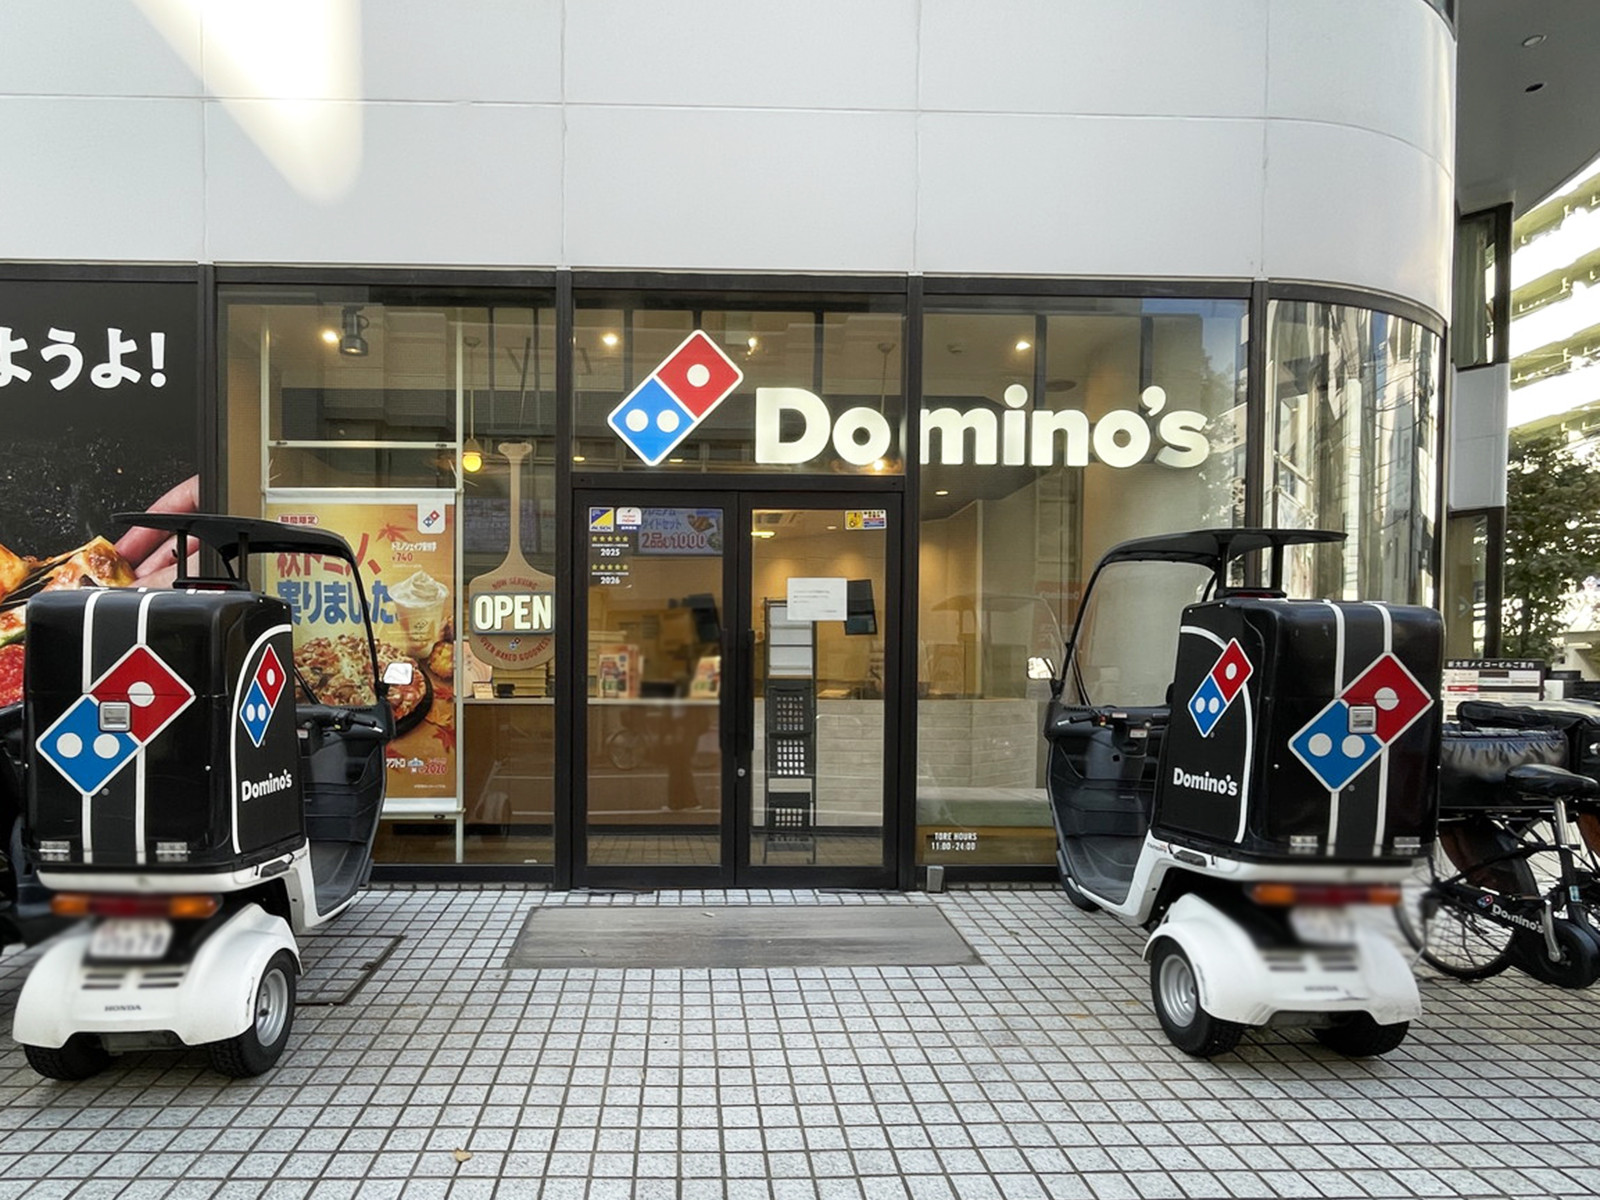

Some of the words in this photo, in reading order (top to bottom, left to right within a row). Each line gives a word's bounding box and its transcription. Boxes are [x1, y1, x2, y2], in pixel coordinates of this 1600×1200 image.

[755, 383, 1210, 468] Domino's
[600, 548, 620, 556] 2025
[492, 579, 507, 590] NOW
[509, 577, 538, 590] SERVING
[277, 580, 399, 626] 実りました
[474, 594, 552, 630] OPEN
[241, 768, 292, 803] Domino's
[1173, 766, 1238, 797] Domino's
[953, 832, 977, 840] HOURS
[1491, 903, 1544, 934] Domino's
[104, 1004, 142, 1012] HONDA
